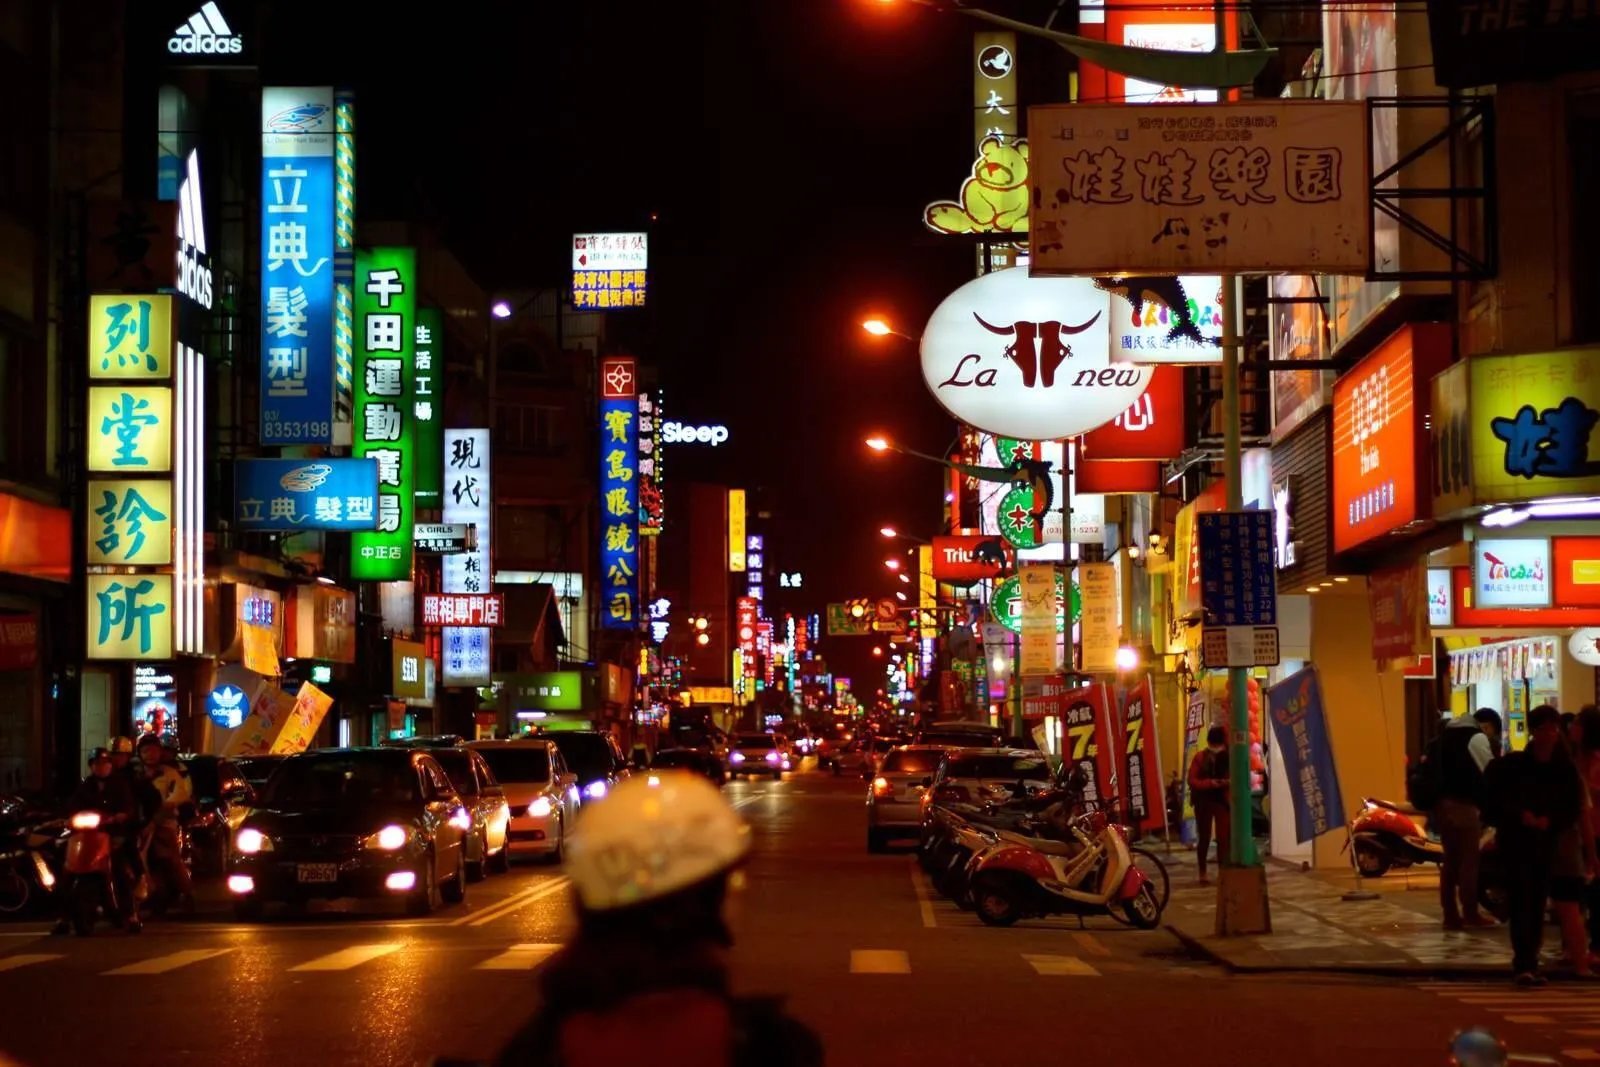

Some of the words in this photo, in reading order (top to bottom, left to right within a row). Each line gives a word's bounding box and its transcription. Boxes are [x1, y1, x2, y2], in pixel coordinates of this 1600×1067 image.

[168, 34, 242, 53] adidas
[1063, 147, 1341, 205] 娃娃樂園
[177, 240, 213, 309] didas
[267, 163, 329, 396] 立典髮型
[938, 354, 997, 389] La
[1072, 367, 1141, 387] new
[264, 422, 329, 437] 8353198
[451, 437, 481, 507] 現代
[239, 497, 373, 524] 立典髮型
[604, 410, 635, 621] 寶島眼鏡公司
[361, 545, 401, 559] 中正店
[424, 596, 499, 624] 照相專門店
